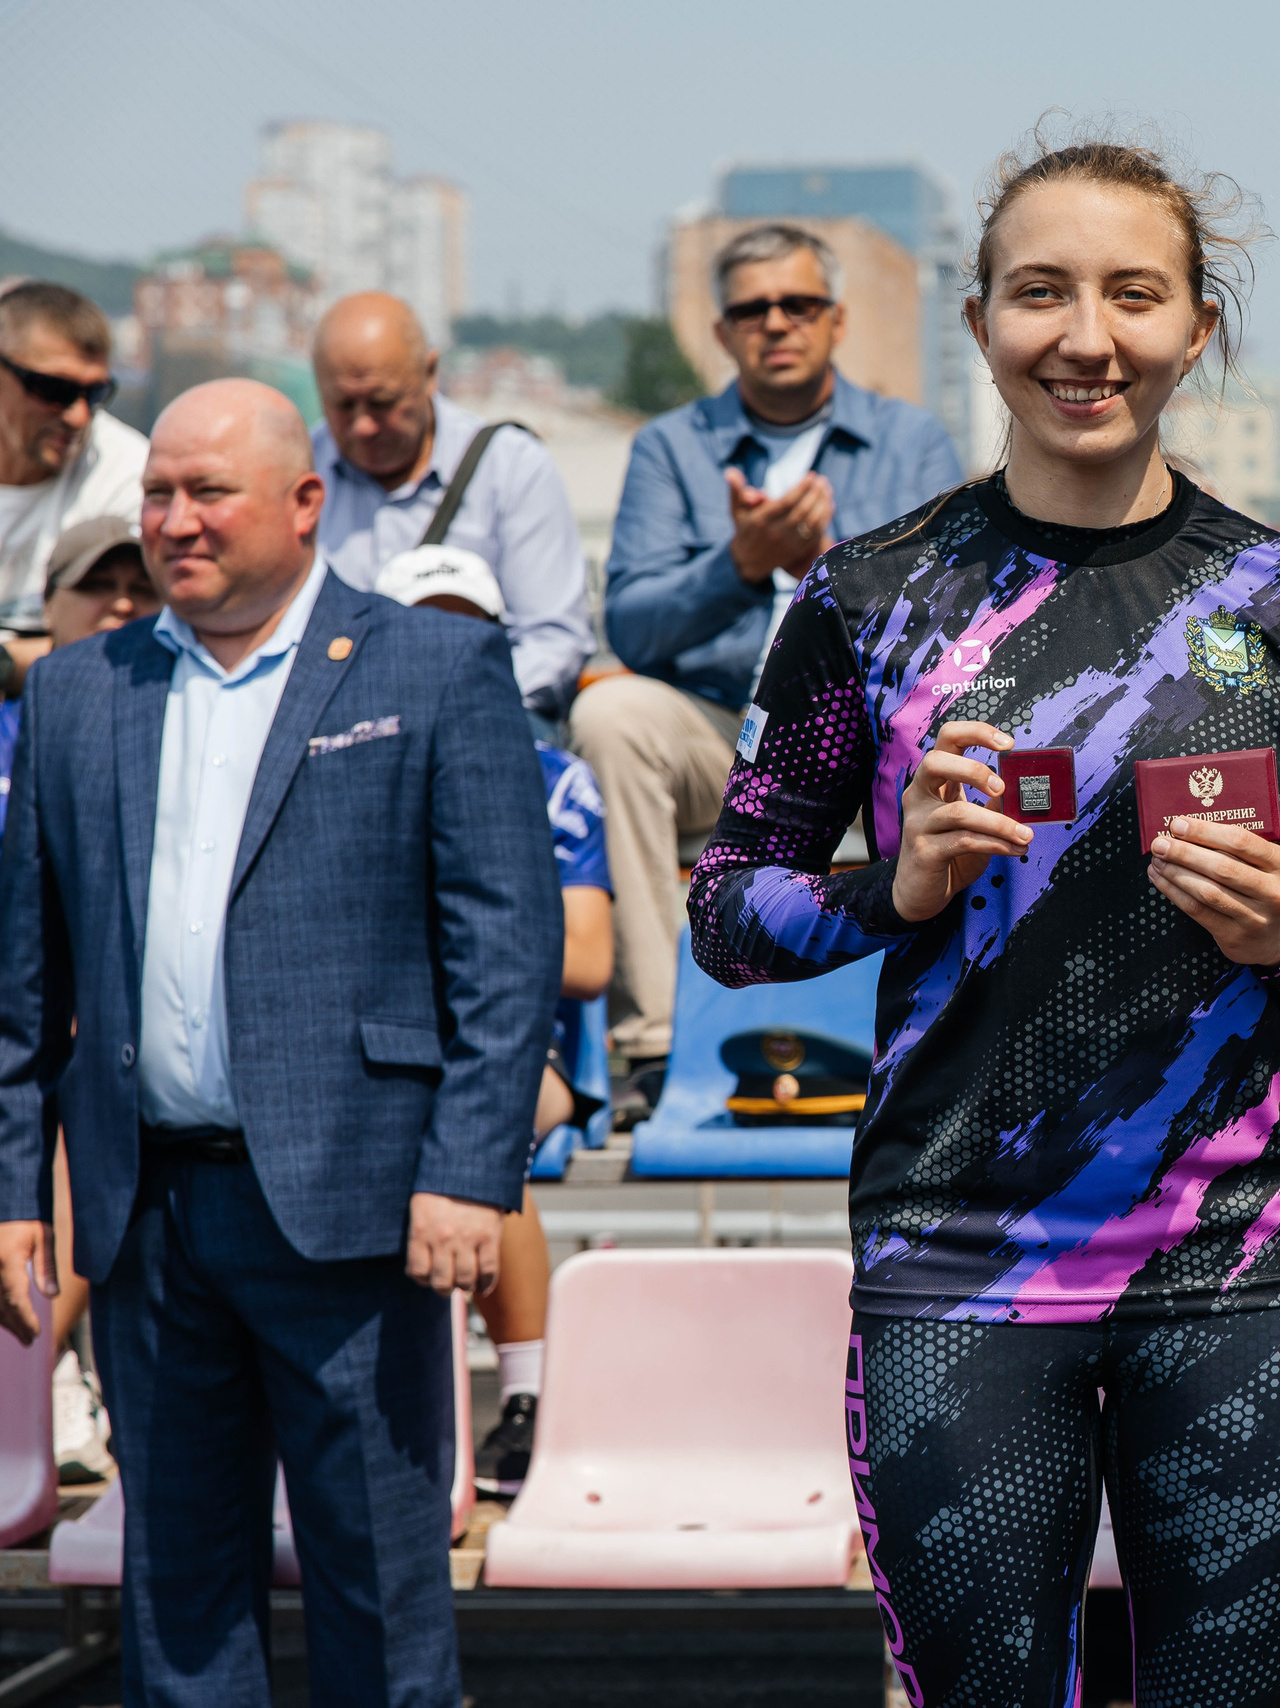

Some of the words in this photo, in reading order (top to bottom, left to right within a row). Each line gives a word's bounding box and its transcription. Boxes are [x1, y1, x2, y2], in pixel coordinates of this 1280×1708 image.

[931, 675, 1016, 696] centurion
[1163, 807, 1256, 827] УТОВЕРЕНИЕ
[1231, 820, 1264, 831] ОССИИ
